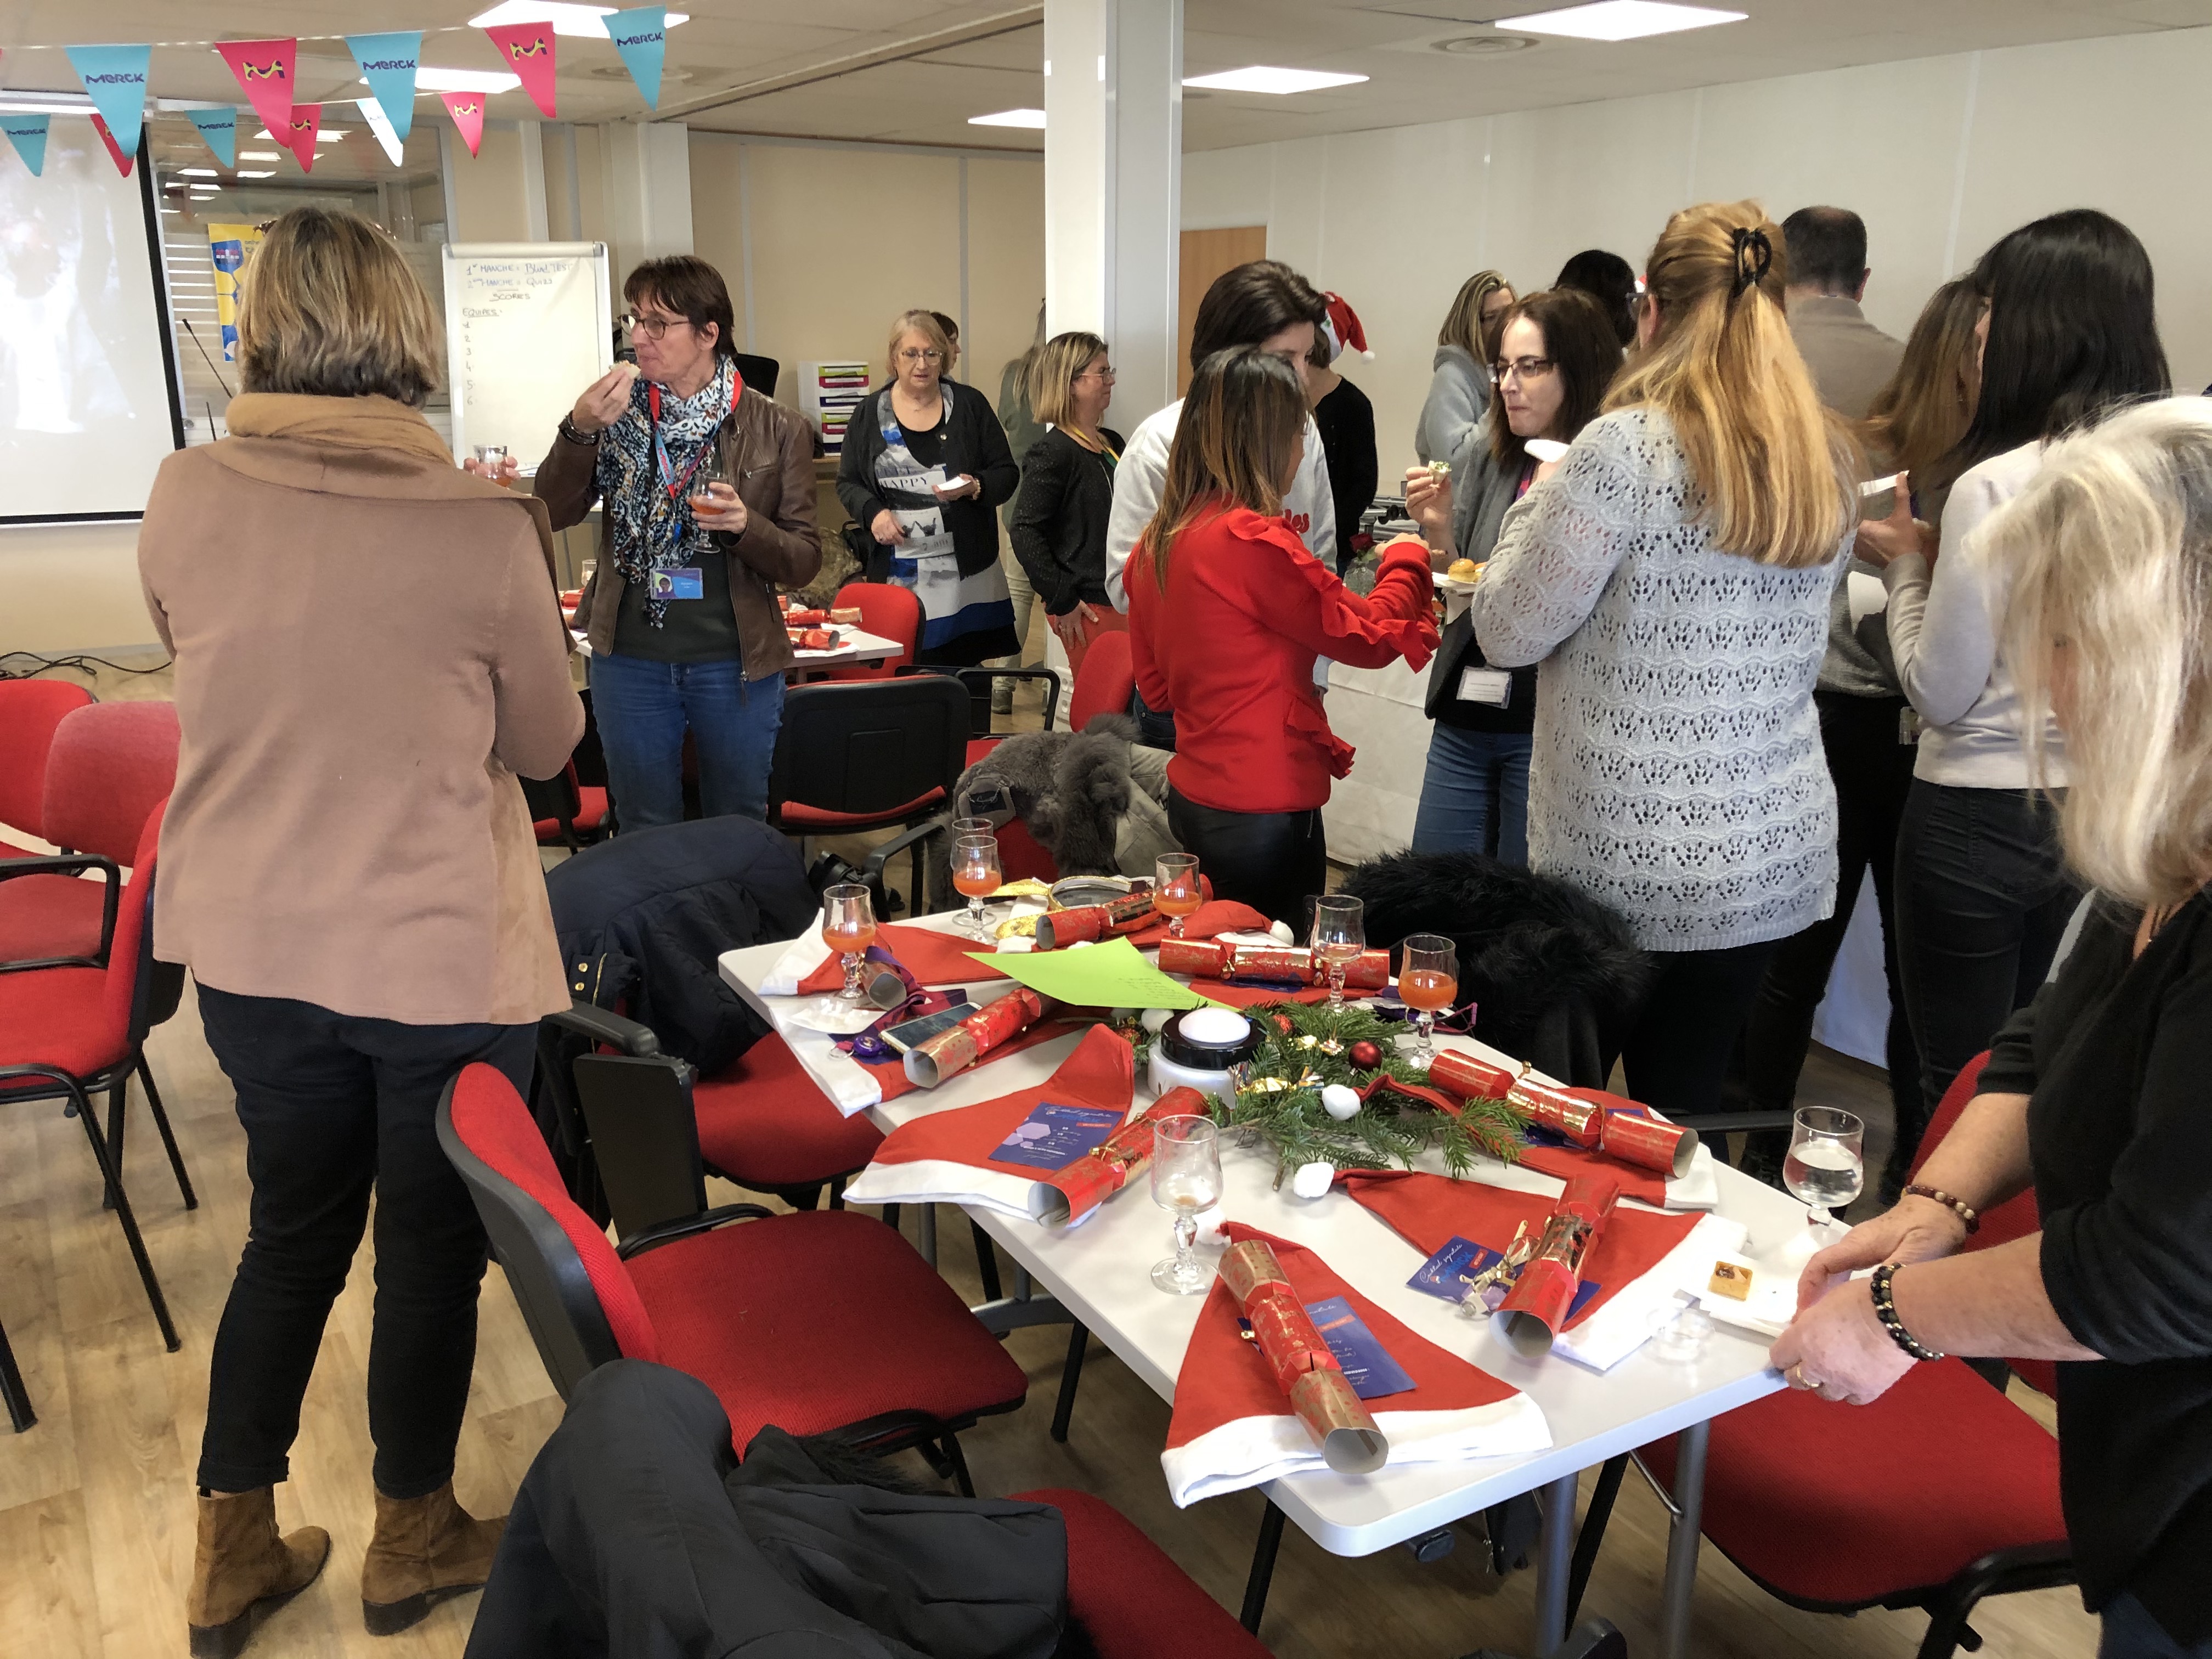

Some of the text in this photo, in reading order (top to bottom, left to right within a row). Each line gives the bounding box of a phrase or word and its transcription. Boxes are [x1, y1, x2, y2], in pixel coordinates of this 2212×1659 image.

[617, 32, 663, 47] MERCK
[363, 59, 415, 71] MERCK
[85, 74, 145, 84] MERCK
[198, 121, 235, 130] MERCK
[7, 127, 46, 136] MERCK
[481, 264, 514, 273] MANCHE
[550, 263, 573, 272] TEST
